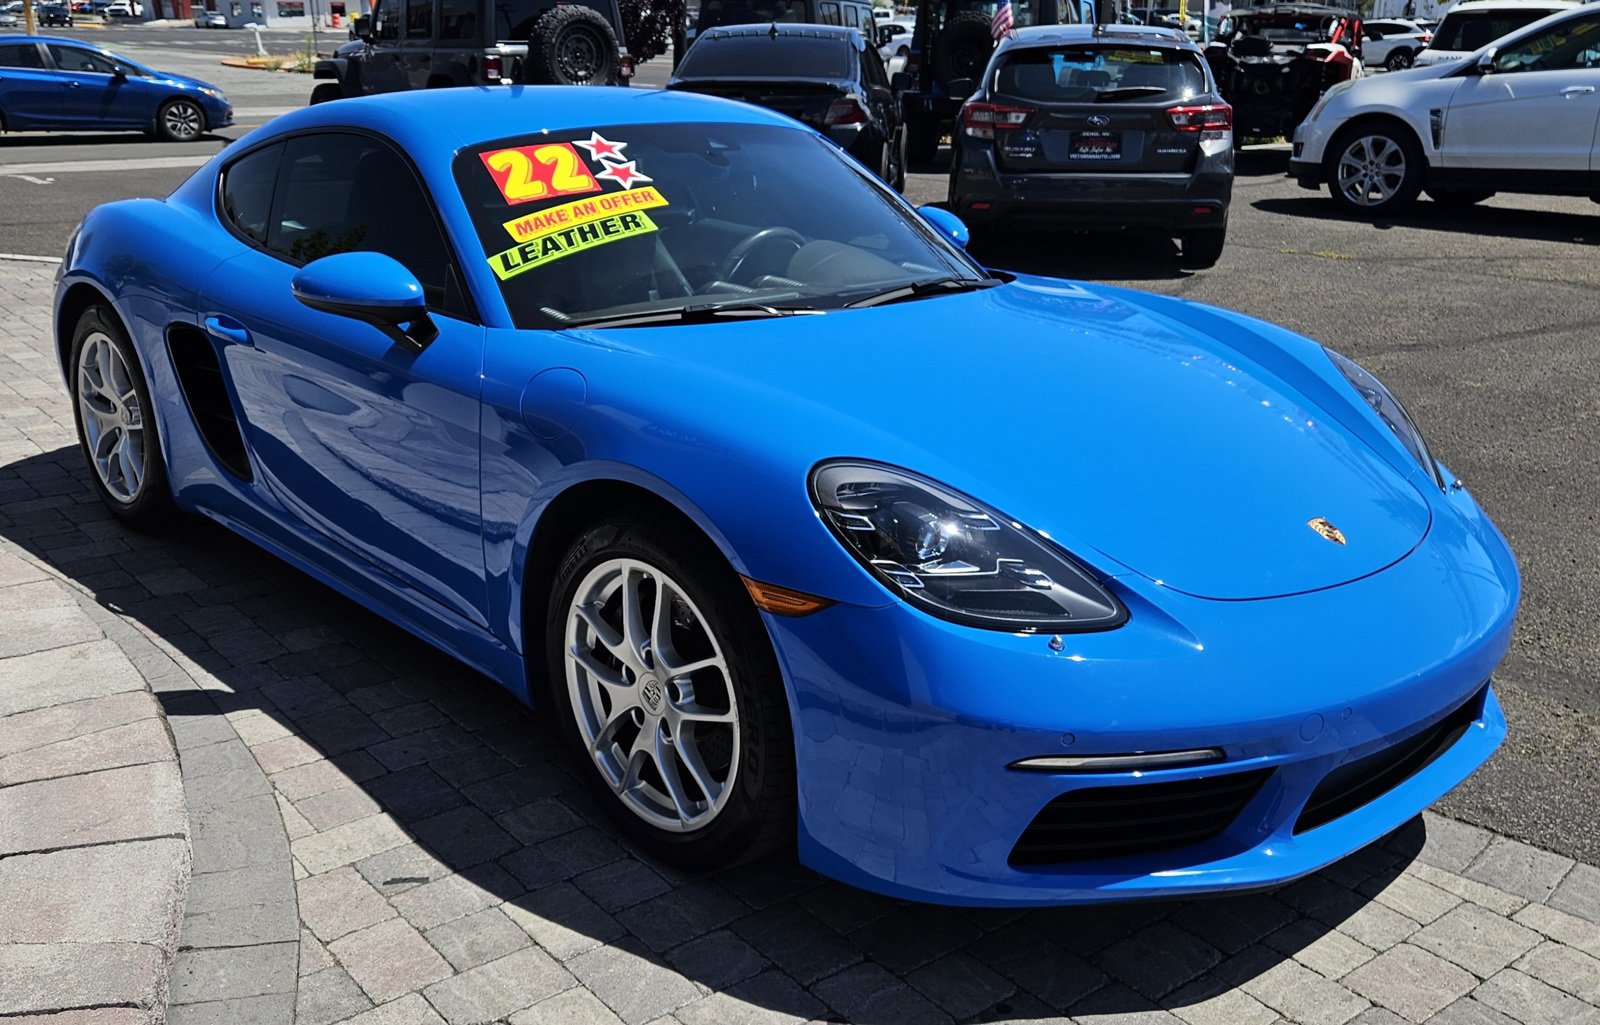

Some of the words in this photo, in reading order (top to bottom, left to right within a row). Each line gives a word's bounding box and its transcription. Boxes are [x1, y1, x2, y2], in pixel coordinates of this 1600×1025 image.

[487, 145, 593, 200] 22
[514, 208, 569, 237] MAKE
[572, 201, 599, 219] AN
[601, 190, 656, 212] OFFER
[499, 213, 643, 273] LEATHER
